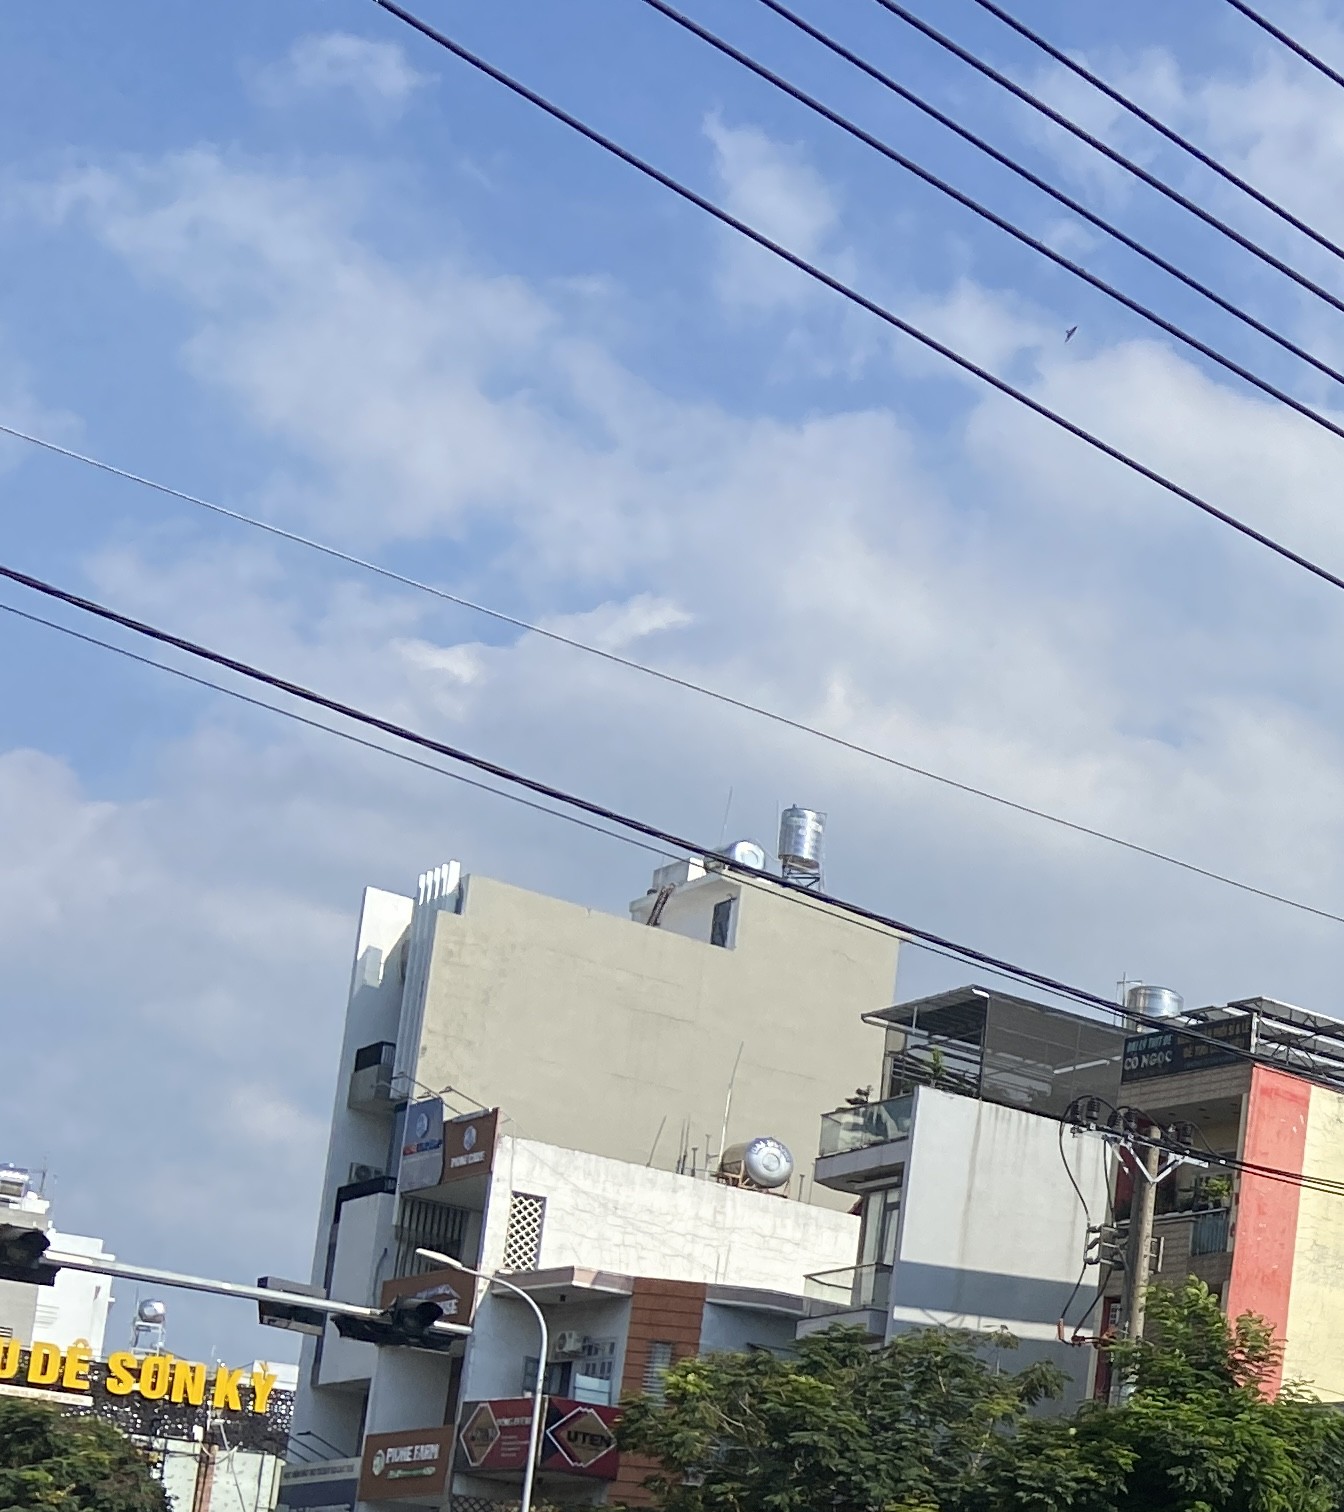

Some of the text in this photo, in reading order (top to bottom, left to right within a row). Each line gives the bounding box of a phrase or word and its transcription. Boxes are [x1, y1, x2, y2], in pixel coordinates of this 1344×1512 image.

[27, 1337, 93, 1390] DÊ
[106, 1351, 207, 1406] SƠN
[213, 1360, 279, 1414] KỲ
